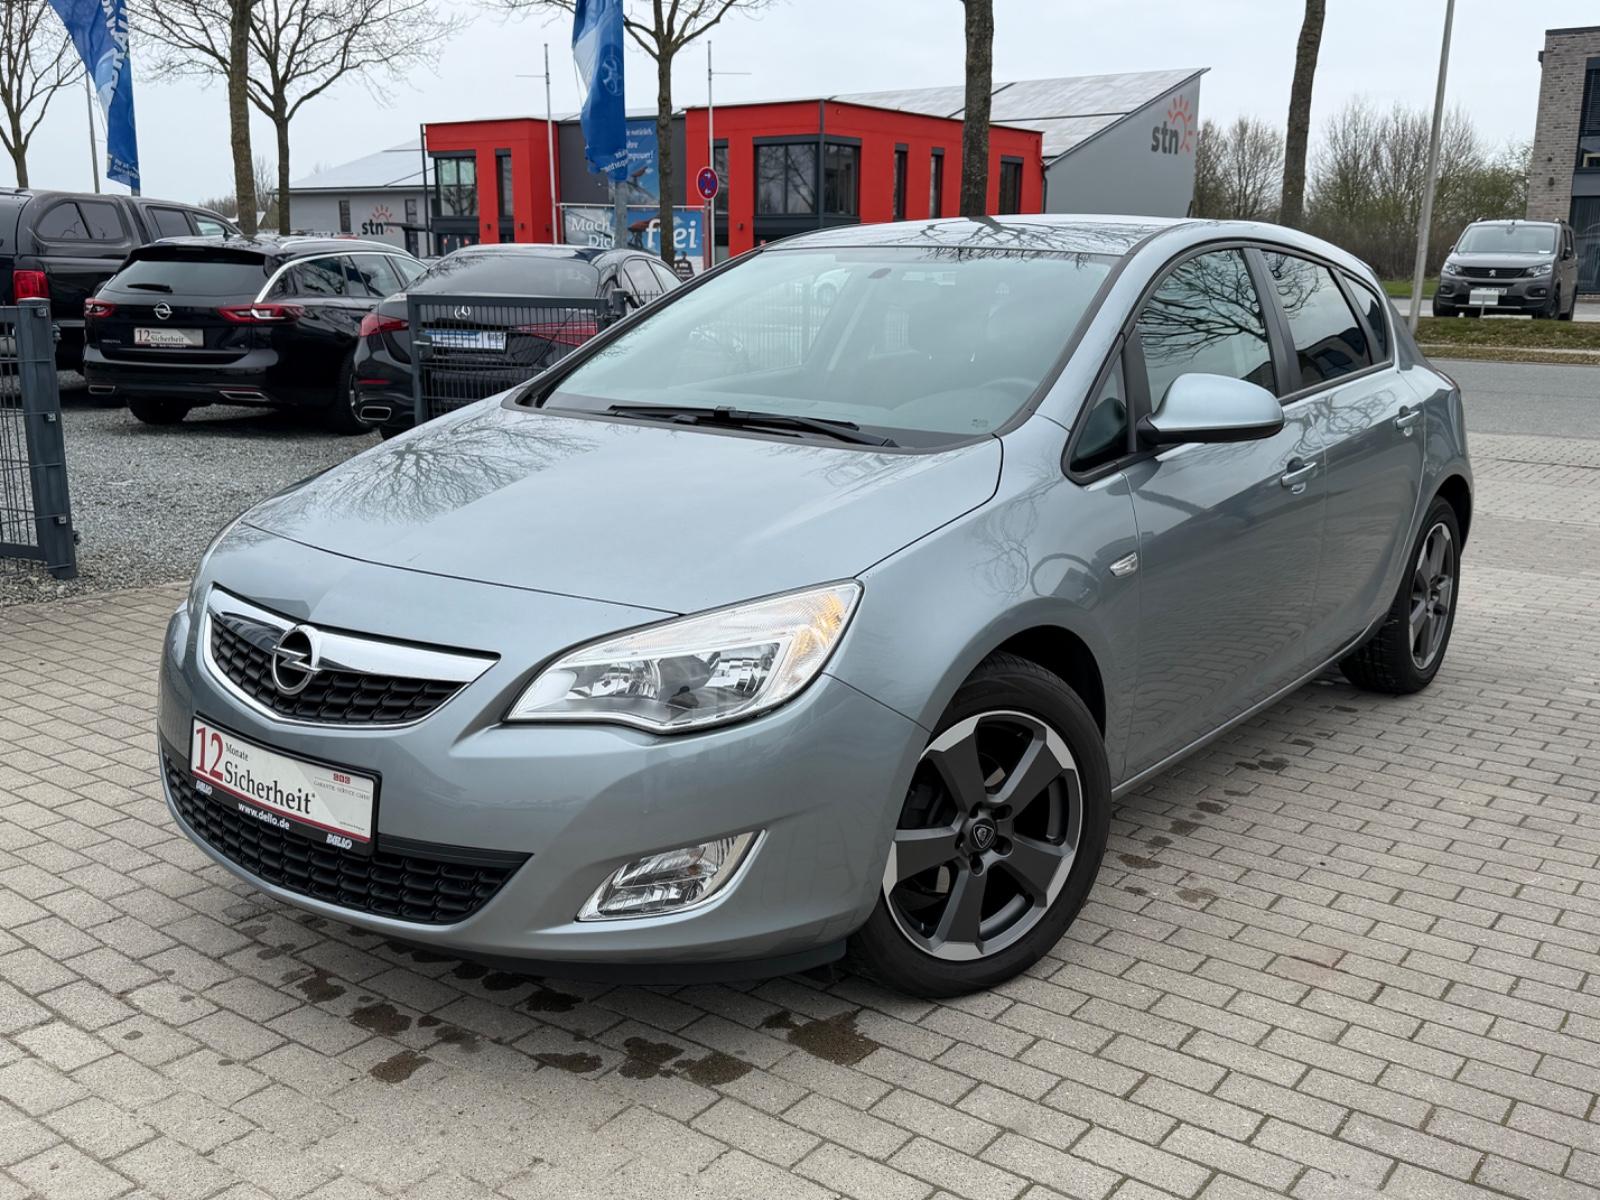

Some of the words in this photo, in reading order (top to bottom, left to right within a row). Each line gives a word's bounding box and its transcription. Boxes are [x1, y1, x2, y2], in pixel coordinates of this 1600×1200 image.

[1151, 121, 1179, 154] stn
[361, 219, 384, 236] stn
[571, 217, 611, 232] Mach
[646, 218, 697, 249] fei
[137, 329, 151, 342] 12
[195, 727, 224, 782] 12
[225, 743, 249, 761] Monate
[238, 803, 290, 830] www.dello.de
